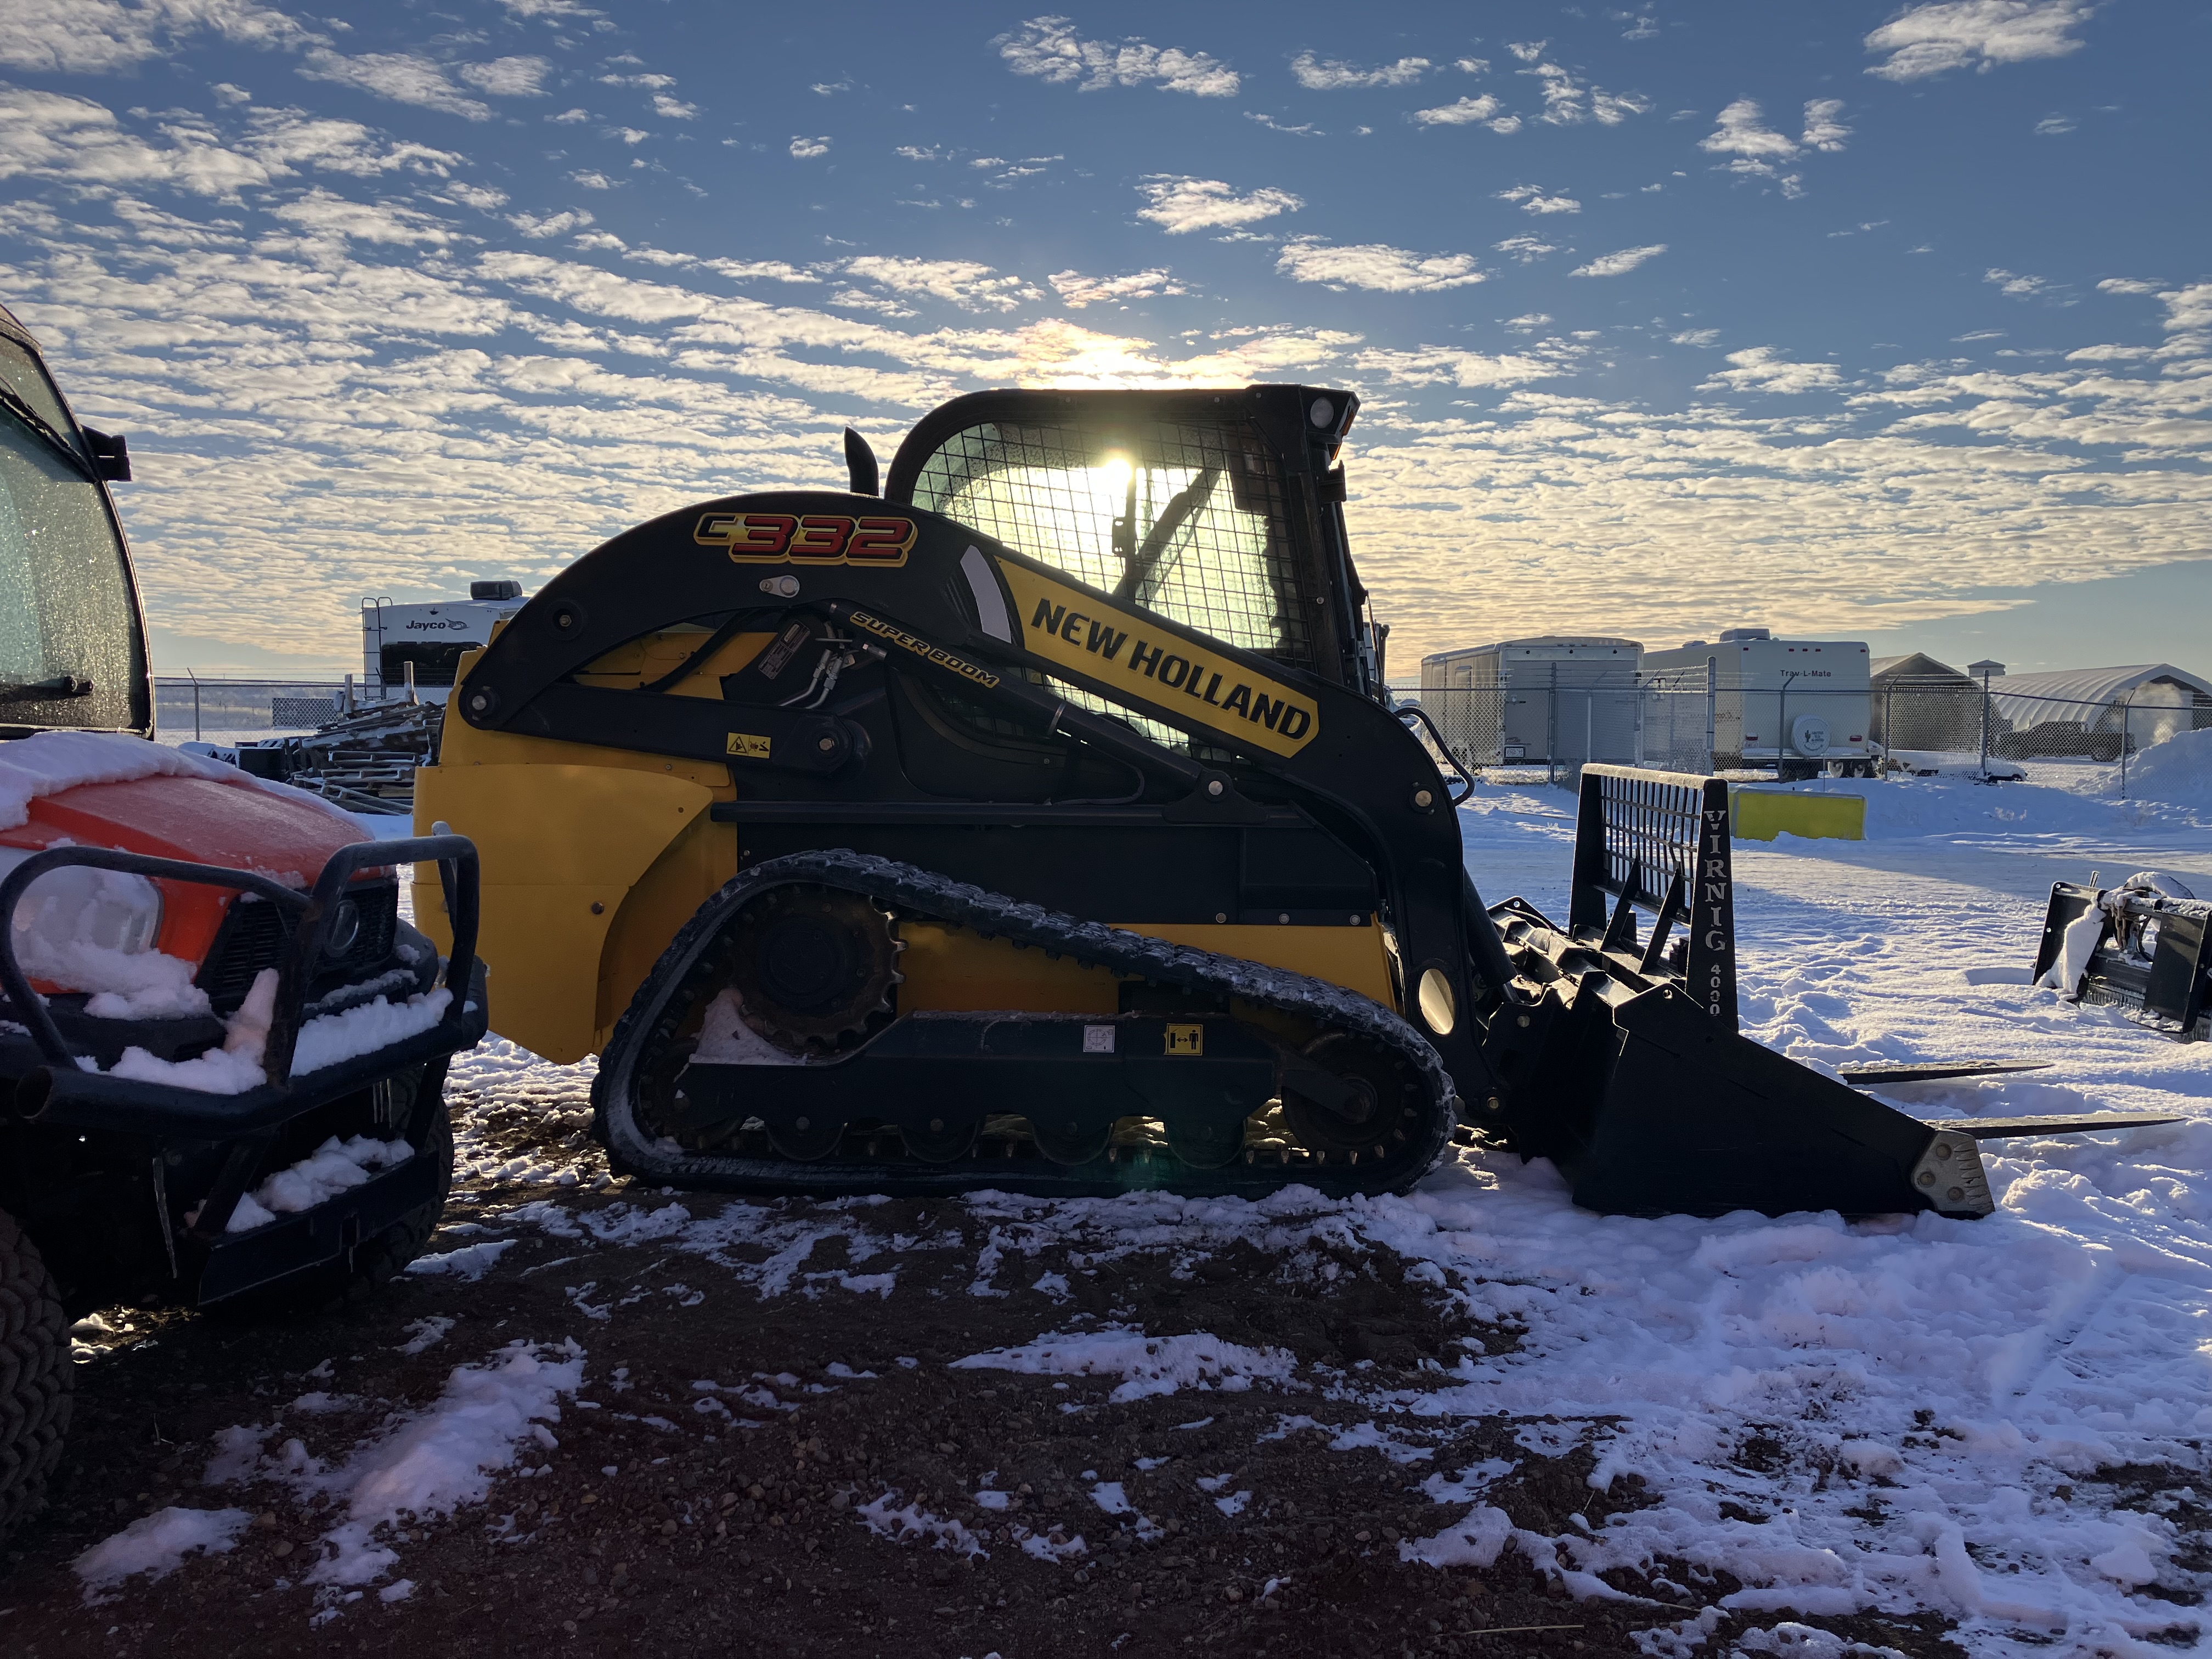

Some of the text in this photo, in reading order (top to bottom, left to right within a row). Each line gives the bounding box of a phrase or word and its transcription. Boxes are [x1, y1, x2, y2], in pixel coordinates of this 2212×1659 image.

[695, 514, 915, 562] C332
[406, 620, 446, 631] Jayco
[851, 612, 929, 653] SUPER
[930, 650, 998, 686] BOOM
[1031, 597, 1311, 740] NEW HOLLAND
[1704, 809, 1728, 1017] VIRNIG 4000
